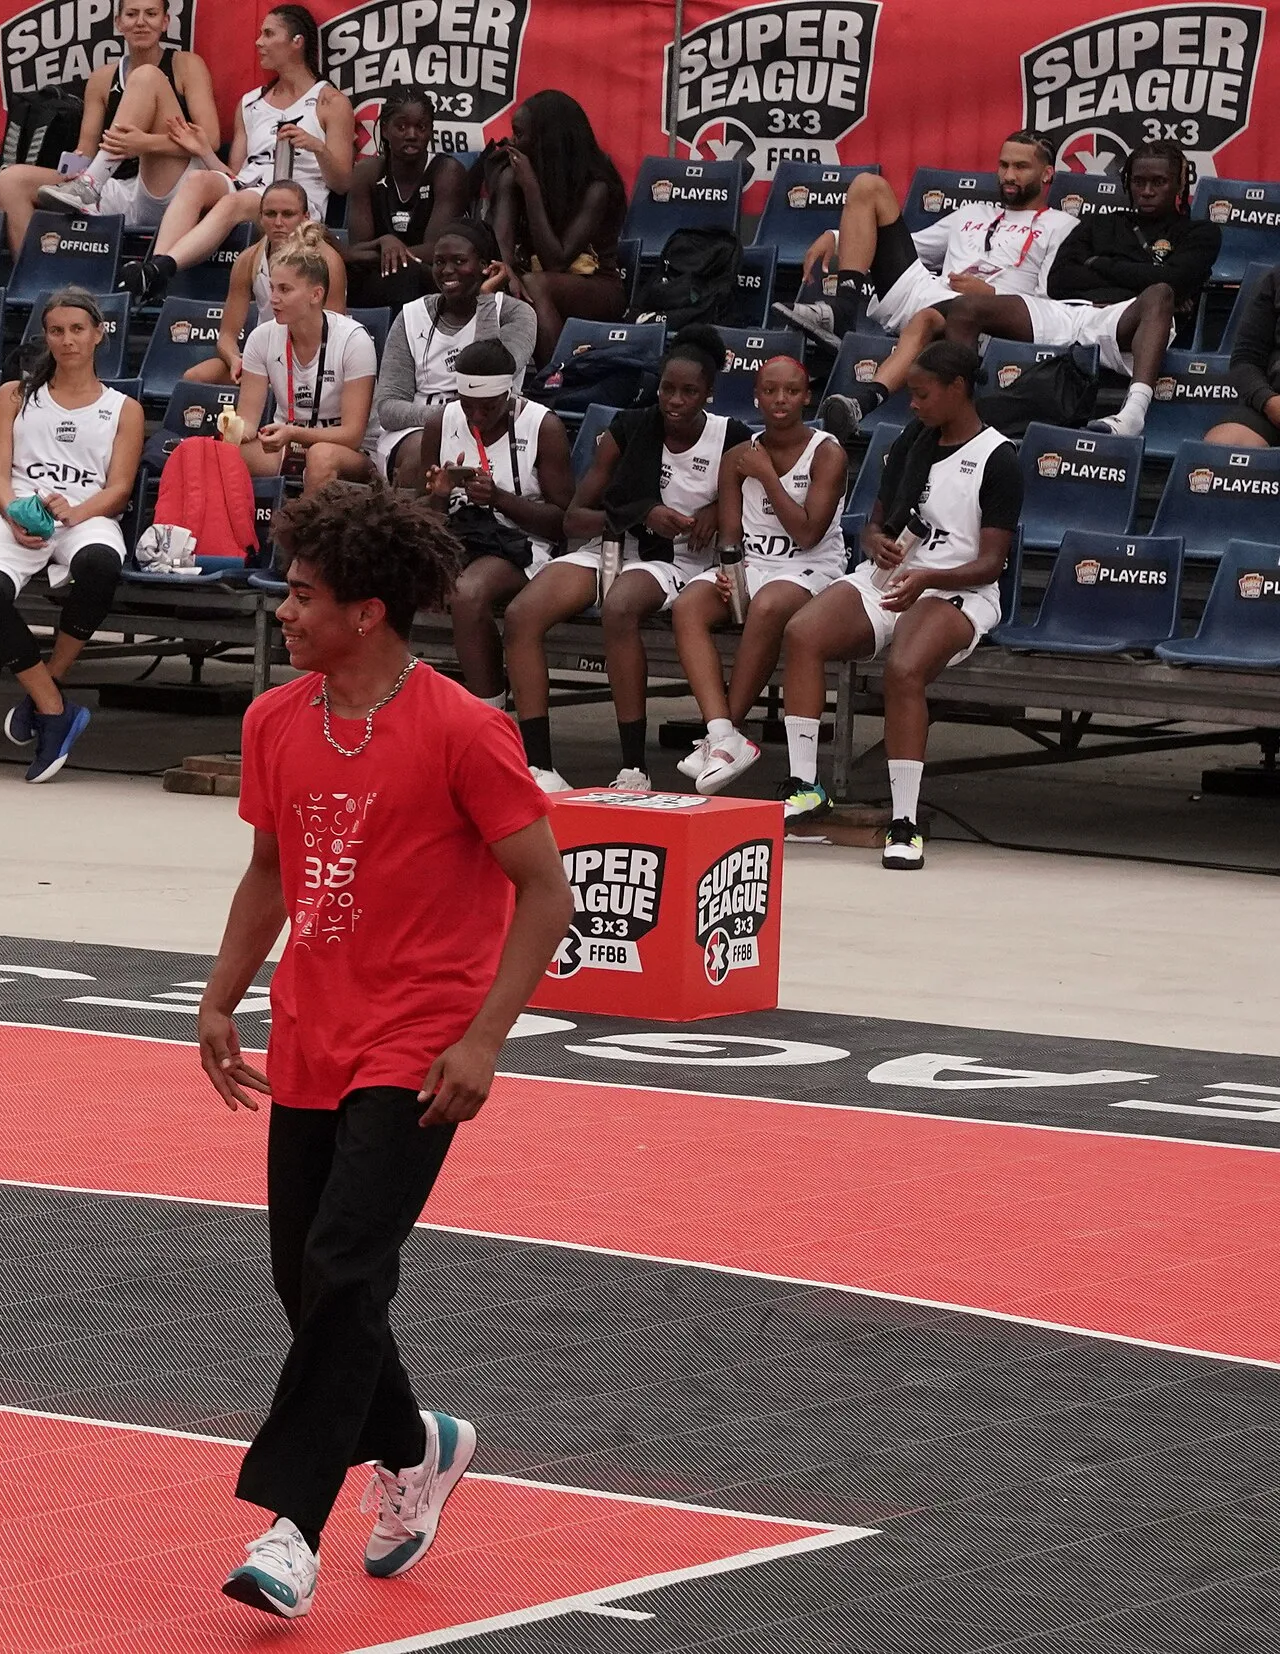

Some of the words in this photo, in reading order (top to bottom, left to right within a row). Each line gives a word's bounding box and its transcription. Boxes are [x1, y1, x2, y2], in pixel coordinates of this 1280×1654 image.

[7, 0, 183, 65] SUP
[327, 0, 516, 66] SUPER
[679, 9, 864, 84] SUPER
[1032, 15, 1249, 95] SUPER
[10, 40, 182, 93] LEAG
[328, 45, 510, 97] LEAGUE
[676, 60, 861, 122] LEAGUE
[1034, 68, 1243, 132] LEAGUE
[767, 107, 822, 135] 3x3
[1141, 117, 1200, 146] 3x3
[430, 130, 468, 153] FBB
[671, 186, 728, 201] PLAYERS
[808, 191, 848, 205] PLAYE
[1230, 207, 1280, 226] PLAYER
[961, 220, 1043, 239] RATORS
[59, 239, 110, 254] OFFICIELS
[210, 250, 240, 264] YERS
[190, 327, 245, 340] PLAYS
[1175, 384, 1239, 399] PLAYERS
[26, 461, 97, 488] GRDF
[692, 463, 707, 473] 2022
[1060, 461, 1127, 483] PLAYERS
[1212, 477, 1280, 494] PLAYERS
[743, 533, 802, 558] RD
[1099, 567, 1168, 585] PLAYERS
[562, 848, 659, 889] PER
[697, 844, 770, 908] SUPER
[571, 883, 656, 923] AGUE
[697, 882, 768, 936] LEAGUE
[590, 916, 629, 937] 3x3
[733, 915, 754, 936] 3x3
[589, 944, 627, 964] FFBB
[732, 943, 752, 963] FFBB
